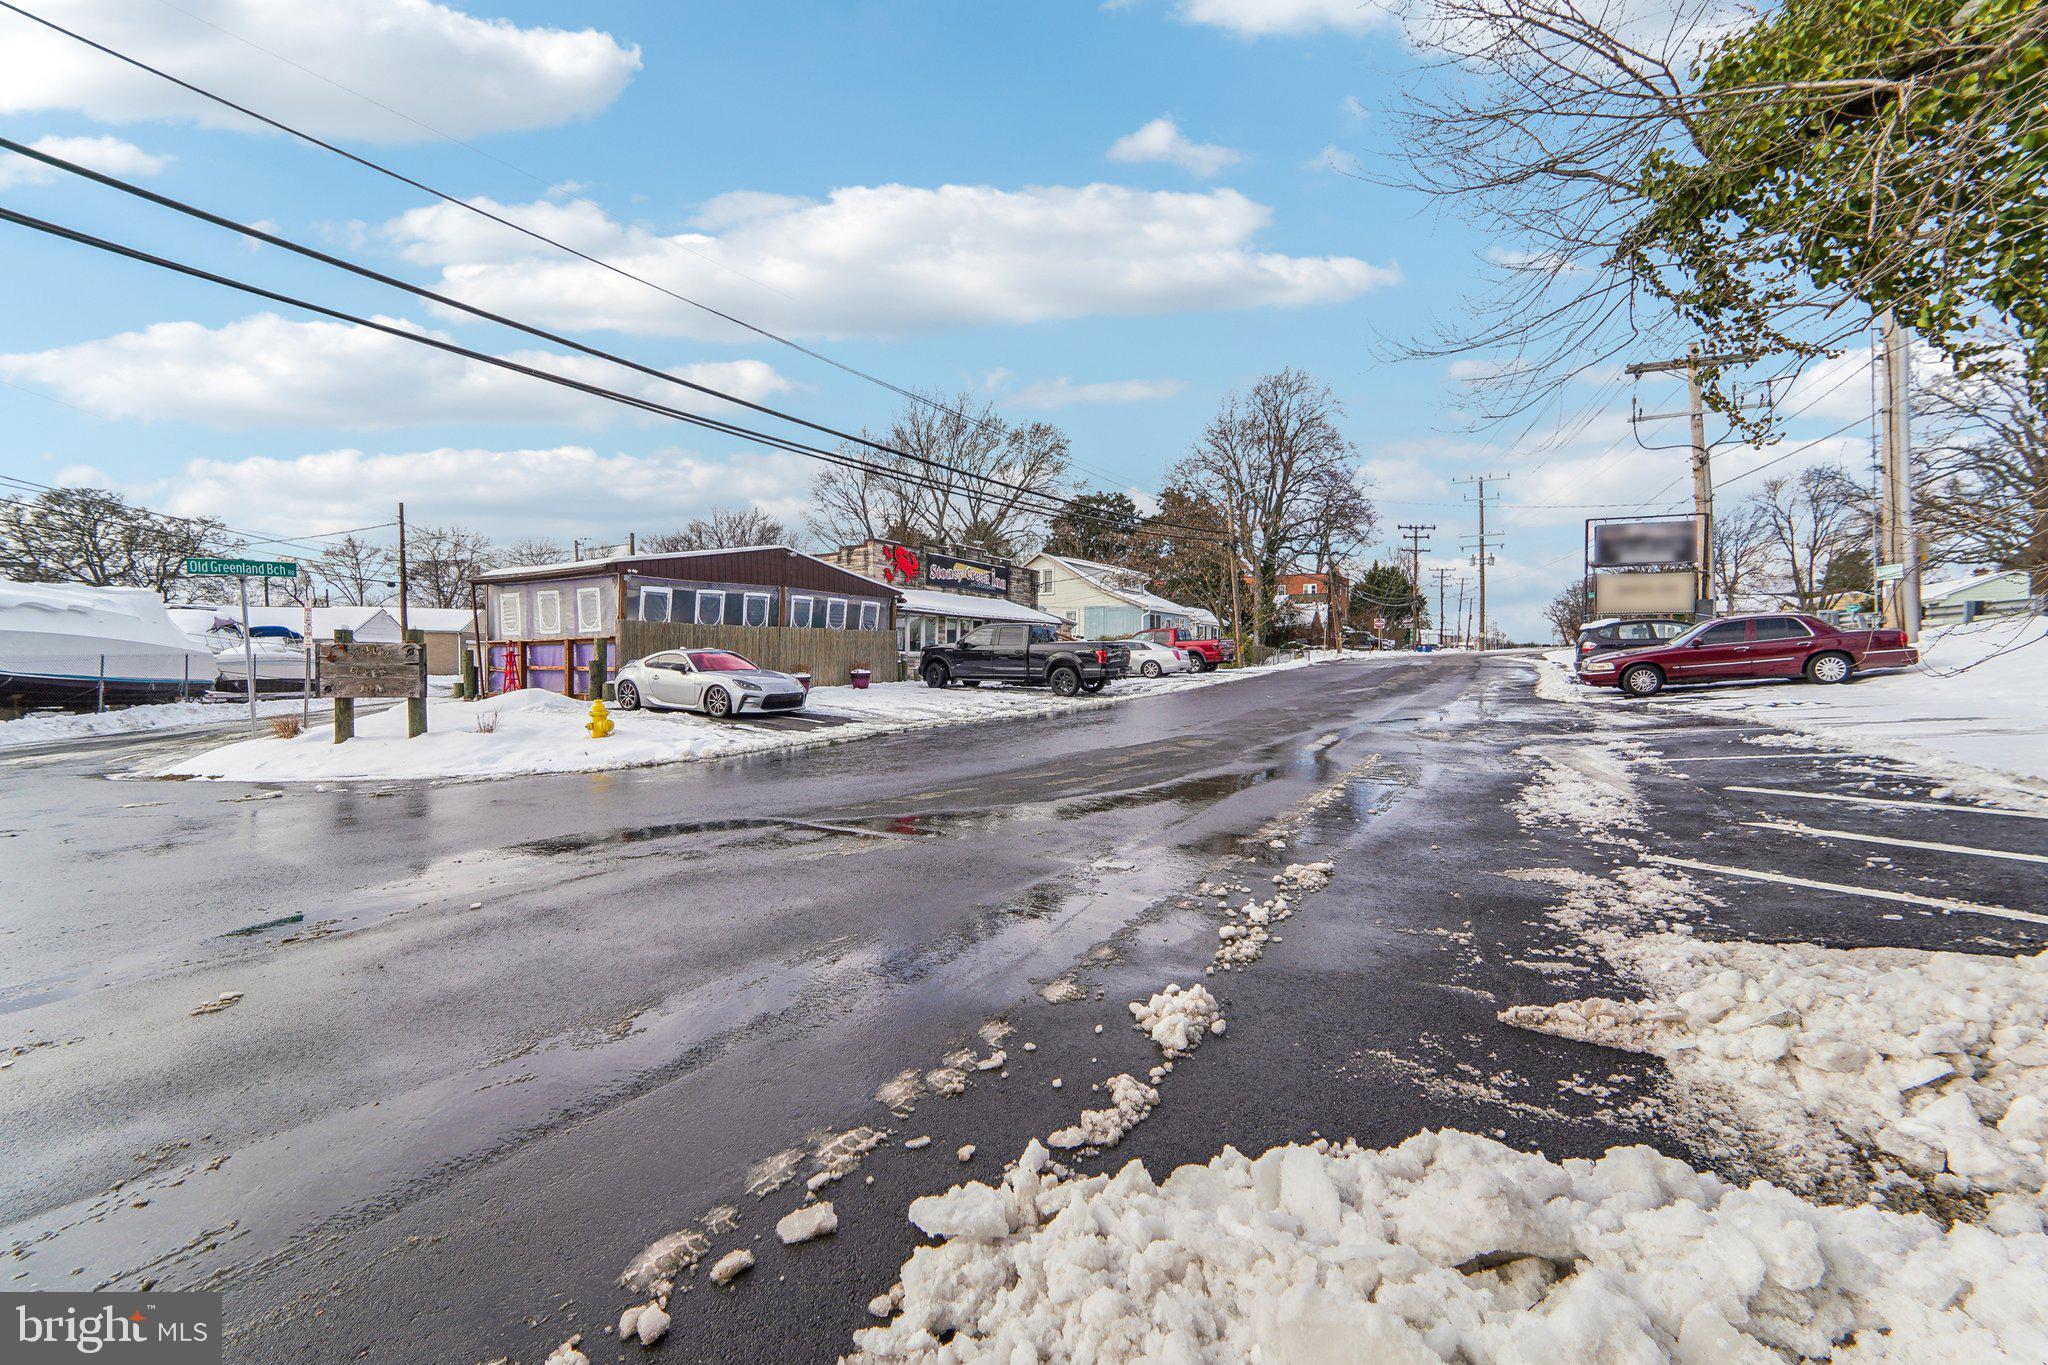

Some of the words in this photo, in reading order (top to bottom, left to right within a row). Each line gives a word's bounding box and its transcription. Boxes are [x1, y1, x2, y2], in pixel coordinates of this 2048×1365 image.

[189, 560, 208, 573] Old
[210, 561, 265, 575] Greenland
[266, 563, 286, 576] Bch
[929, 563, 964, 583] Stoney
[991, 567, 1007, 591] Inn
